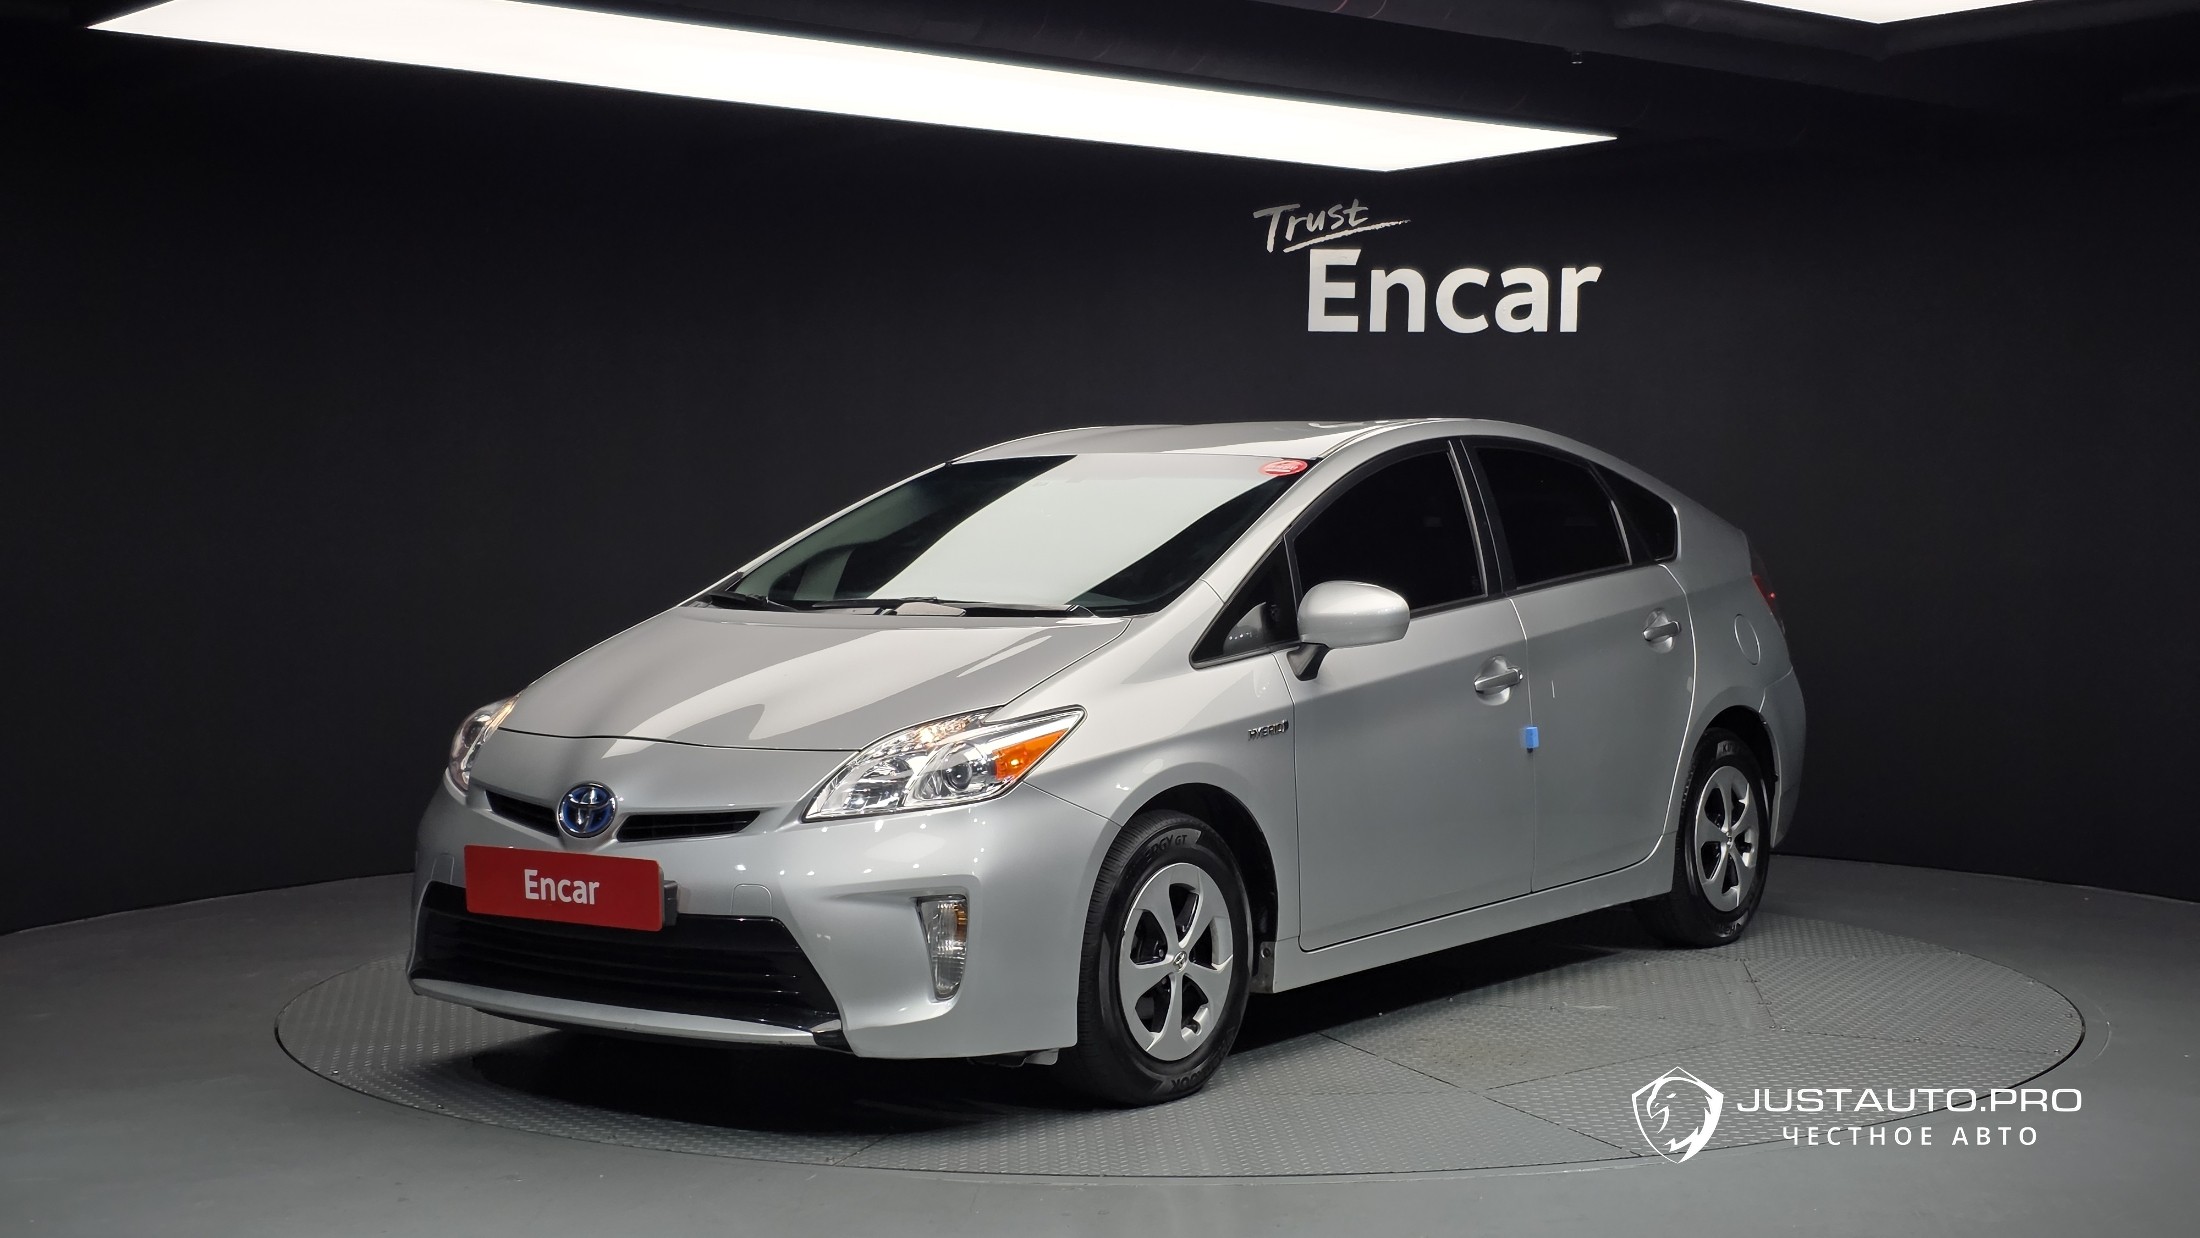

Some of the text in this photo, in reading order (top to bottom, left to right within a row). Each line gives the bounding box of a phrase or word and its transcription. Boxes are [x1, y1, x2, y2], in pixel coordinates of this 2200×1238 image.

[1253, 198, 1370, 253] Trust
[1307, 248, 1603, 334] Encar
[524, 868, 600, 905] Encar
